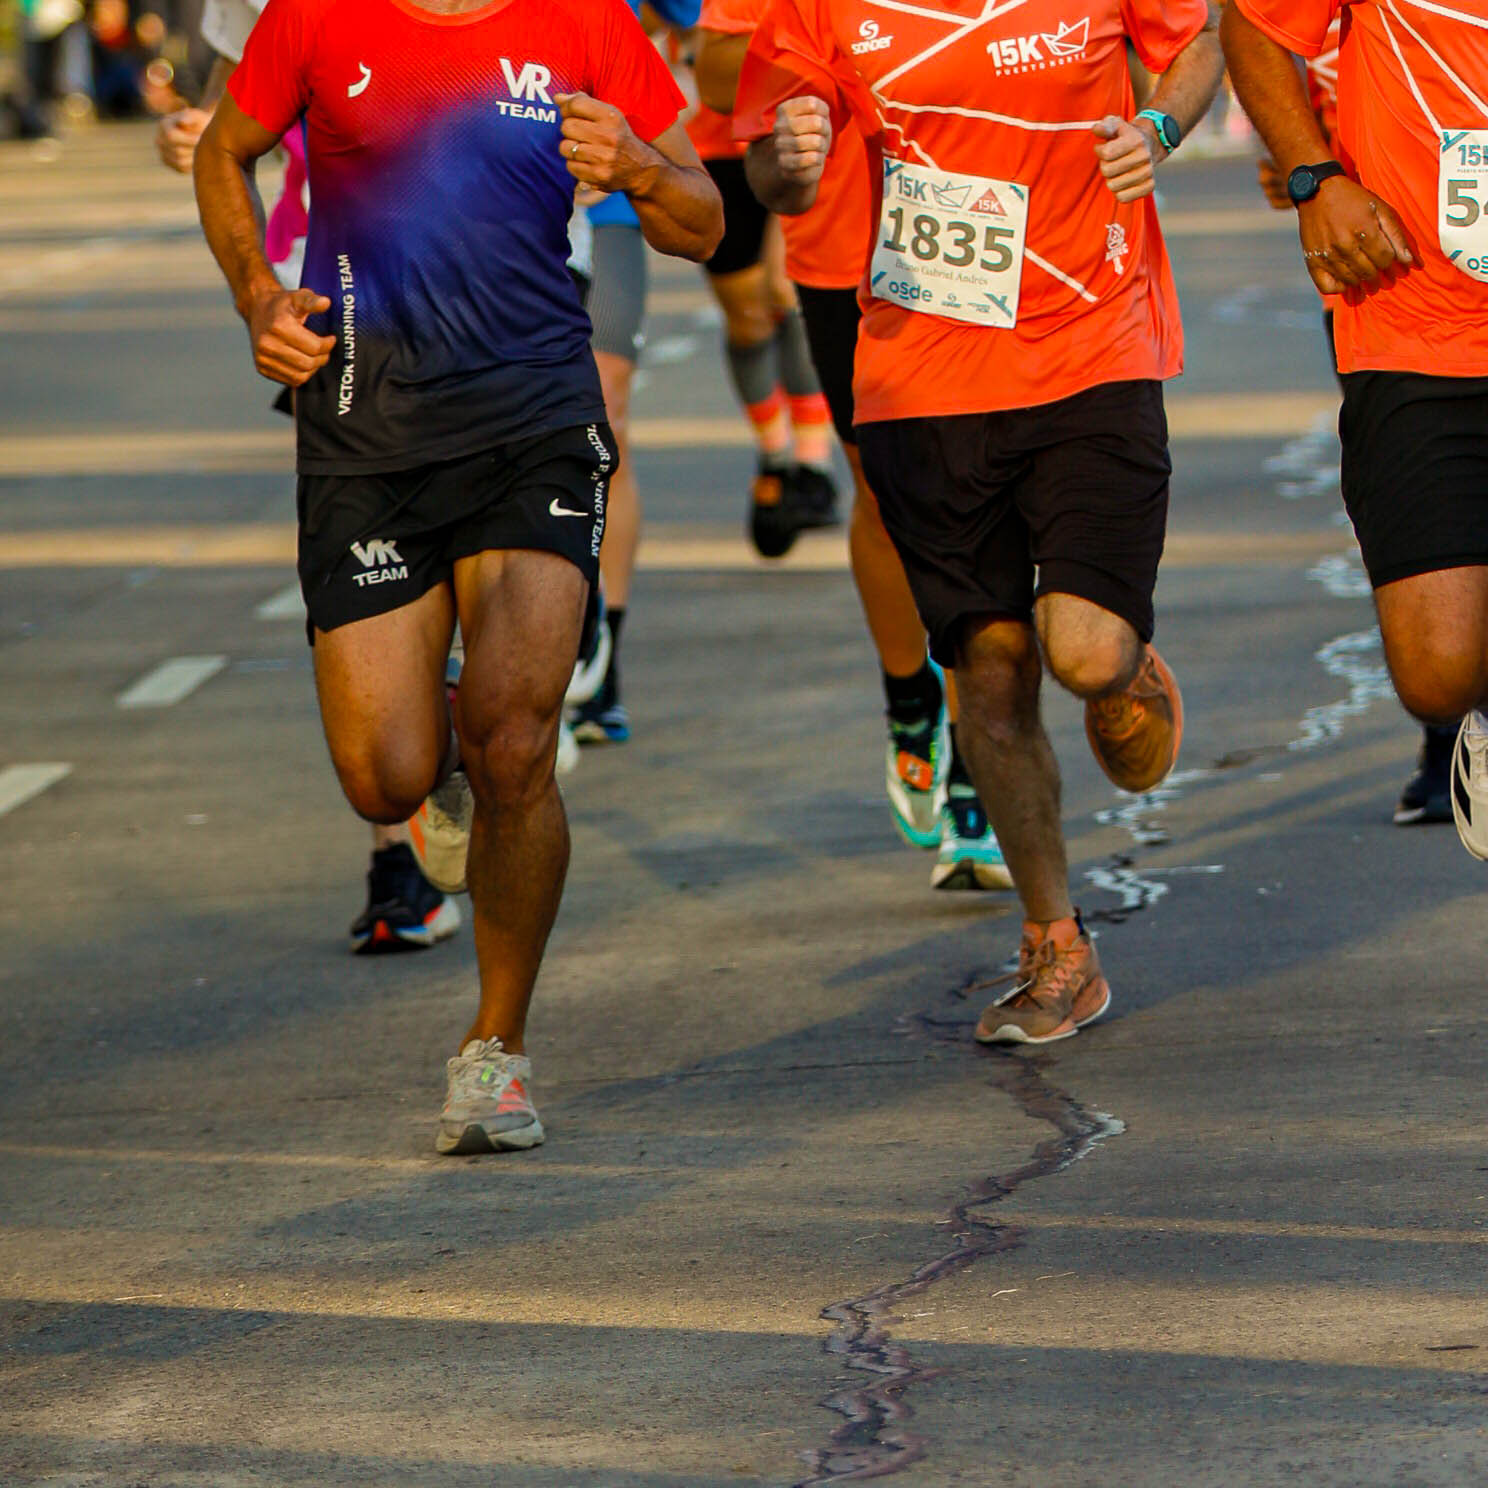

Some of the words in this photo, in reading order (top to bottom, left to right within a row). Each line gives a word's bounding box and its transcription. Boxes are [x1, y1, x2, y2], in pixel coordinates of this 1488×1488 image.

[986, 34, 1044, 68] 15K
[996, 62, 1046, 77] PUERTO
[1050, 51, 1087, 67] NORTE
[498, 57, 554, 105] VR
[495, 100, 557, 124] TEAM
[896, 174, 929, 201] 15K
[977, 198, 1000, 213] 15K
[882, 206, 1015, 273] 1835
[337, 254, 355, 291] TEAM
[888, 280, 933, 302] osde
[352, 565, 409, 587] TEAM
